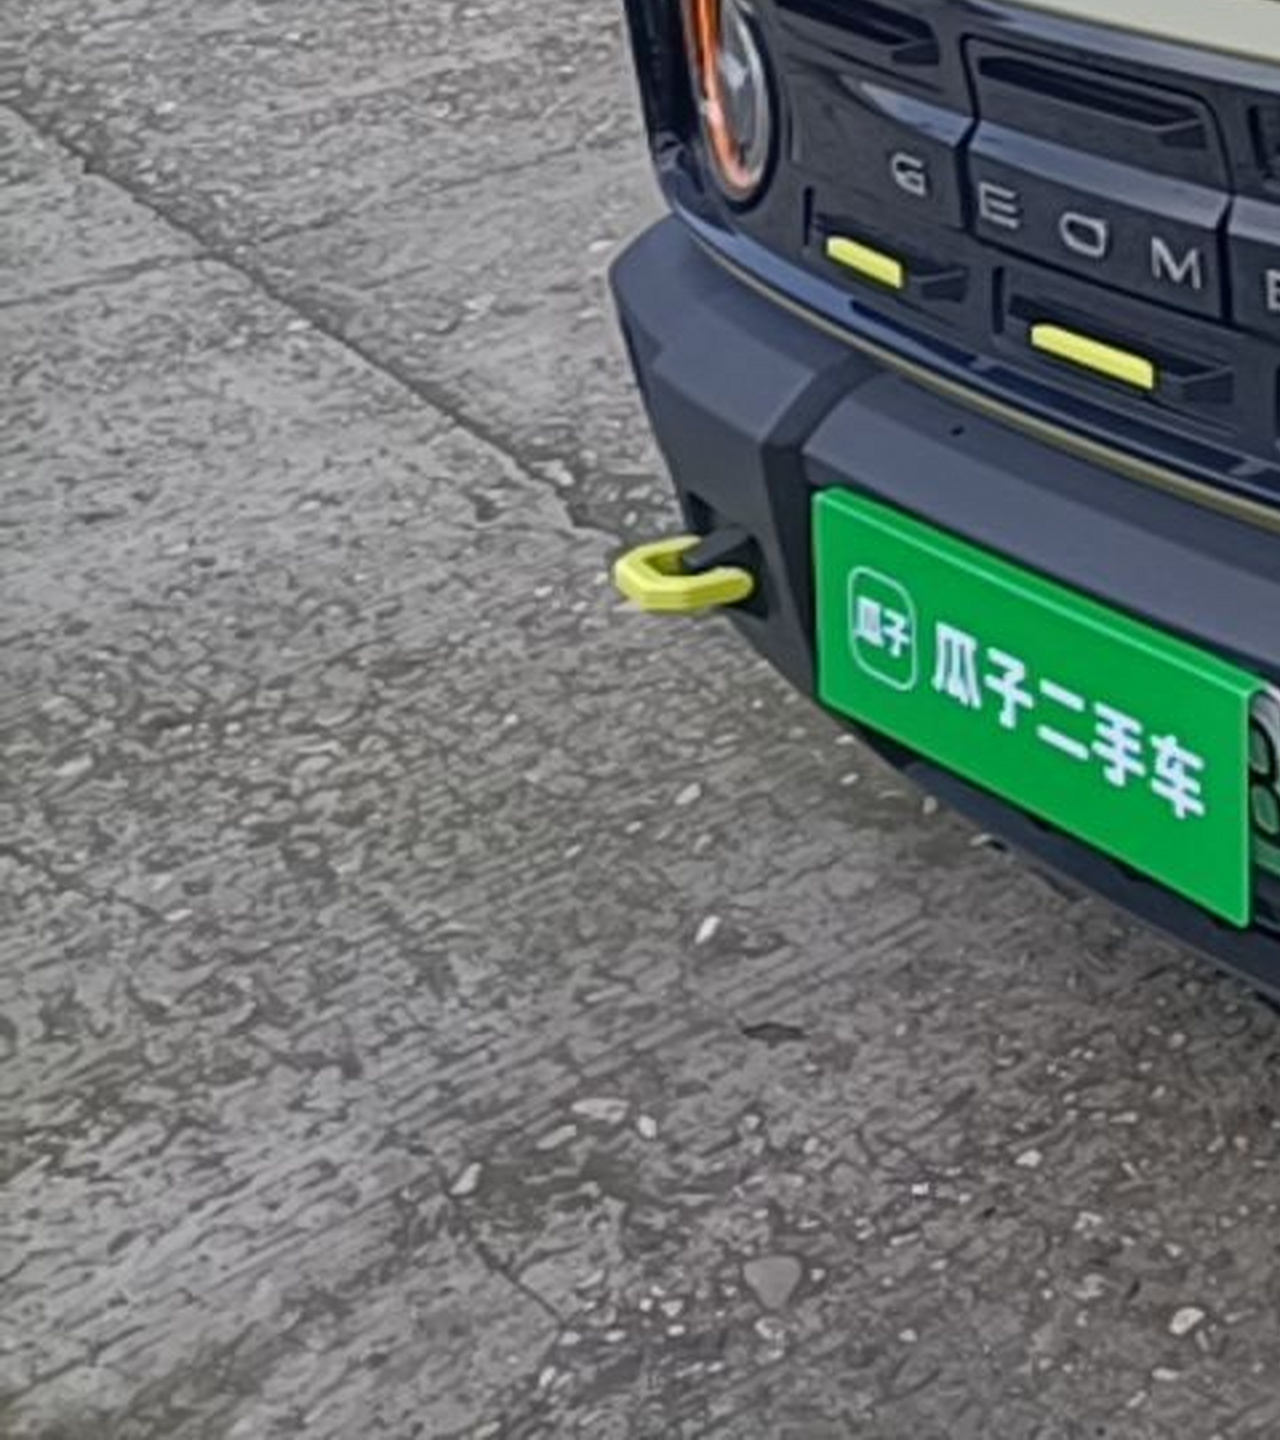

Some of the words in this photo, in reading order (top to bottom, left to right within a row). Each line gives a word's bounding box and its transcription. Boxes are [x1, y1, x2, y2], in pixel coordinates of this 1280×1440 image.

[854, 595, 912, 658] 瓜子
[932, 621, 1206, 821] 瓜子二手车
